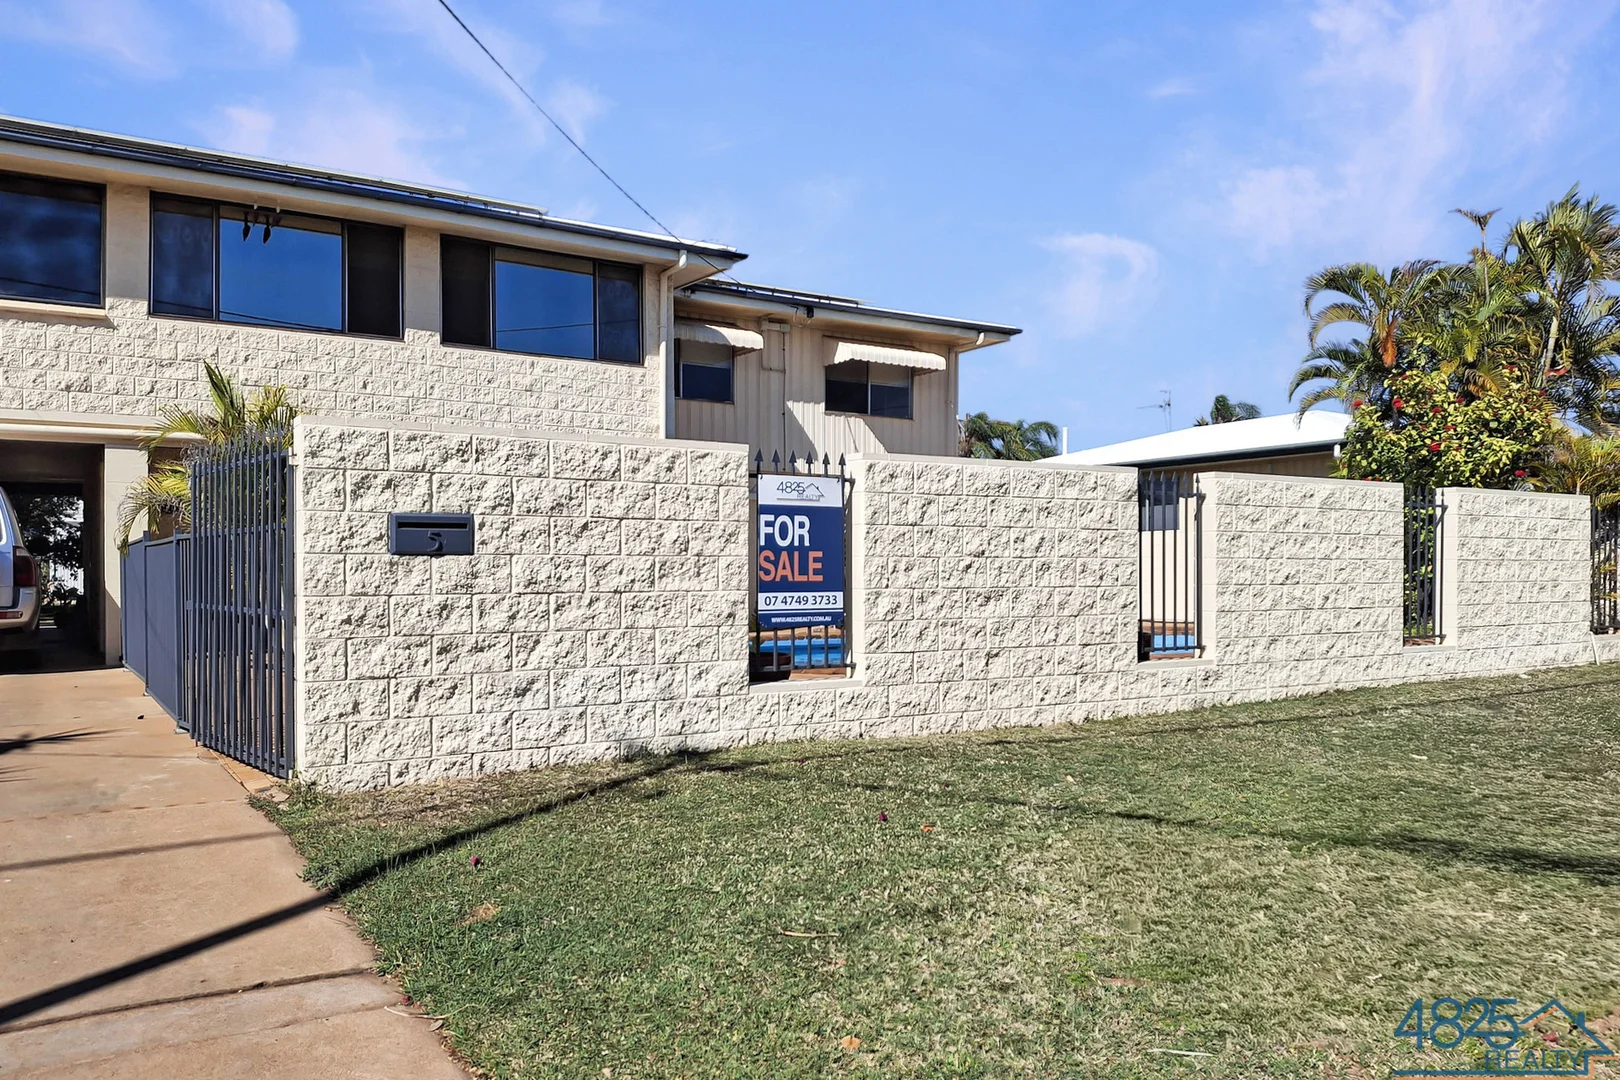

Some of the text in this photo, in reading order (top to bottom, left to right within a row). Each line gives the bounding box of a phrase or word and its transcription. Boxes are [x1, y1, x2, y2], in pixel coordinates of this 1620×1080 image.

[776, 481, 806, 494] 4825
[759, 514, 811, 547] FOR
[427, 530, 444, 552] 5
[758, 549, 823, 582] SALE
[764, 595, 838, 606] 07 4749 3733
[771, 615, 832, 623] WWW.4825REALTY.COM.AU
